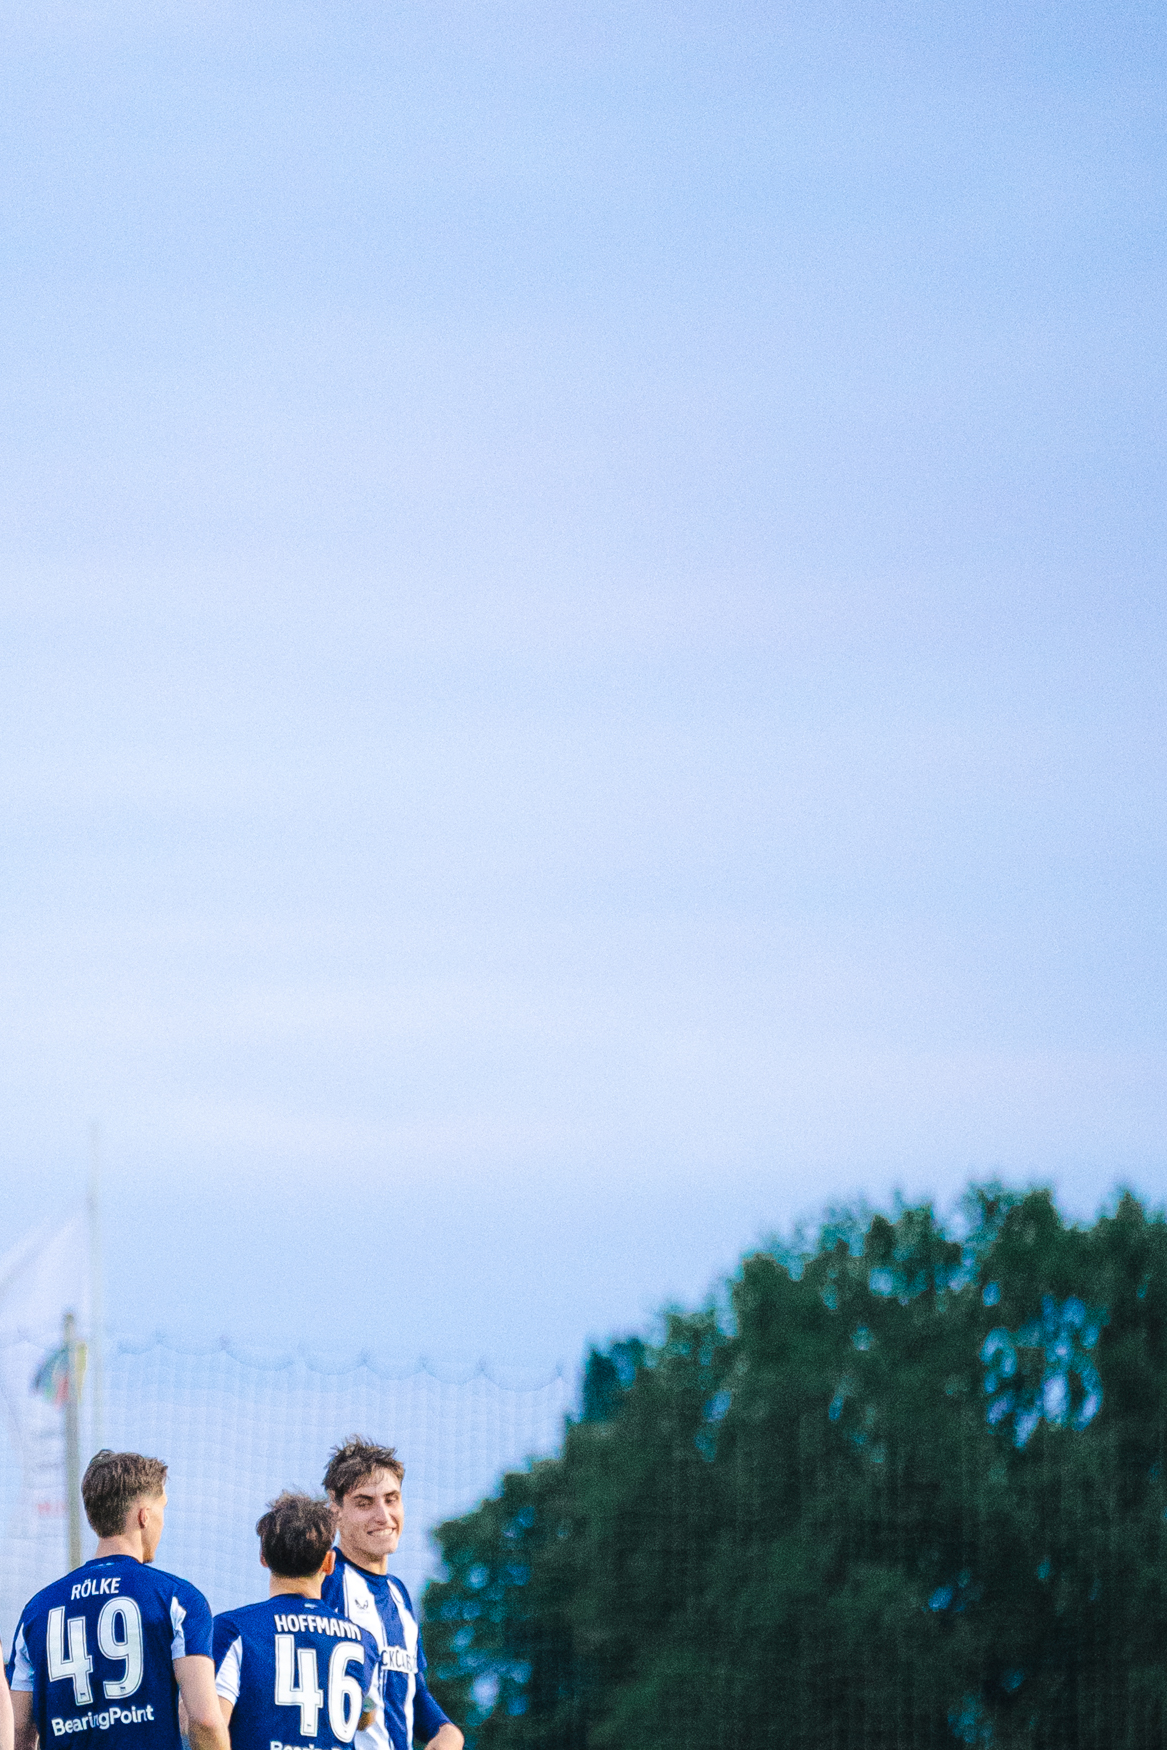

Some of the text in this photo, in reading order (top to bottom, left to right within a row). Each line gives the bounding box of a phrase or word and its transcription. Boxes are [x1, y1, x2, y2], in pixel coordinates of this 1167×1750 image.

[71, 1577, 121, 1601] RÖLKE
[274, 1614, 362, 1641] HOFFMANN
[46, 1596, 144, 1707] 49
[274, 1633, 365, 1743] 46
[51, 1704, 154, 1737] BearingPoint
